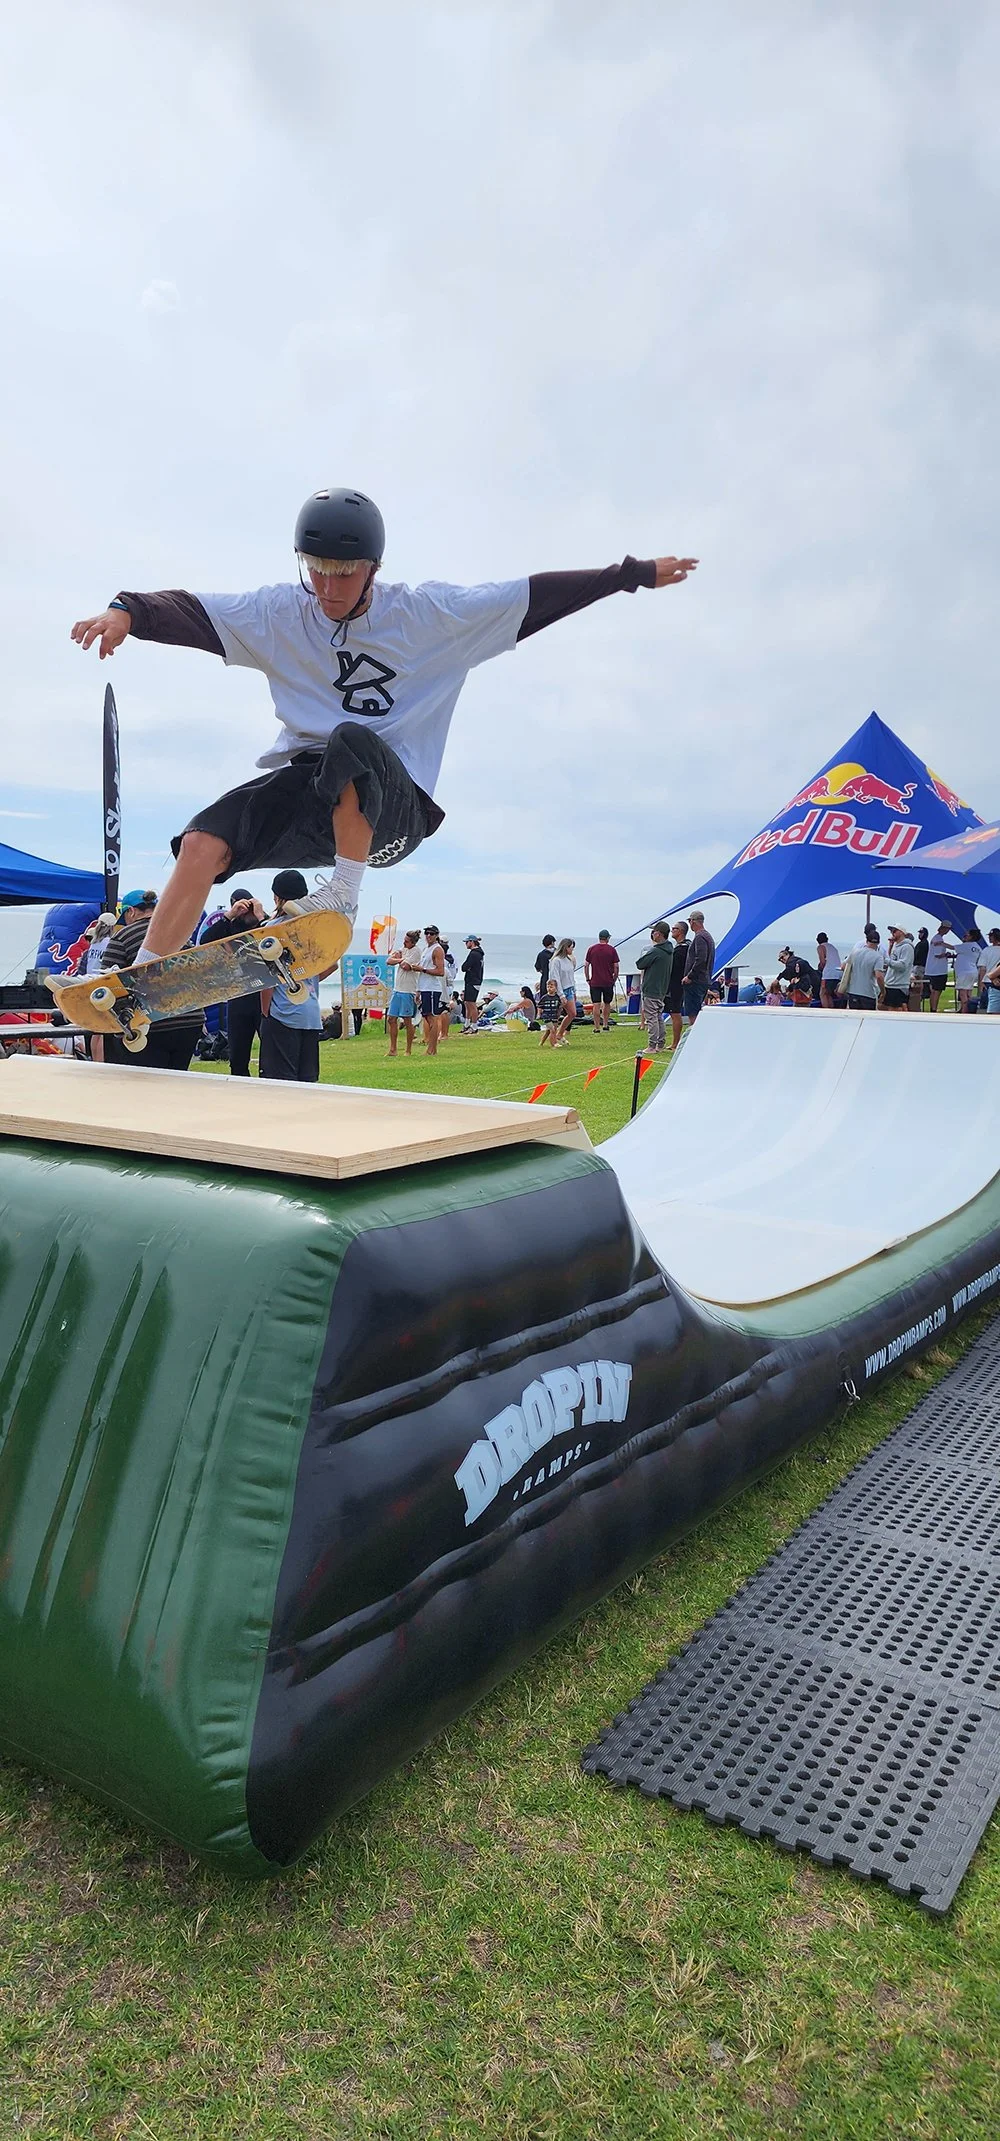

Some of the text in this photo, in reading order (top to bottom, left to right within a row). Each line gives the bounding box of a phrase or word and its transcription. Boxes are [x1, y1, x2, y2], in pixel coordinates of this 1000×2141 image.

[733, 809, 922, 869] Red Bull
[864, 1305, 947, 1378] WWW.DROPINRAMPS.COM
[454, 1359, 633, 1527] DROPIN
[521, 1443, 582, 1495] RAMPS
